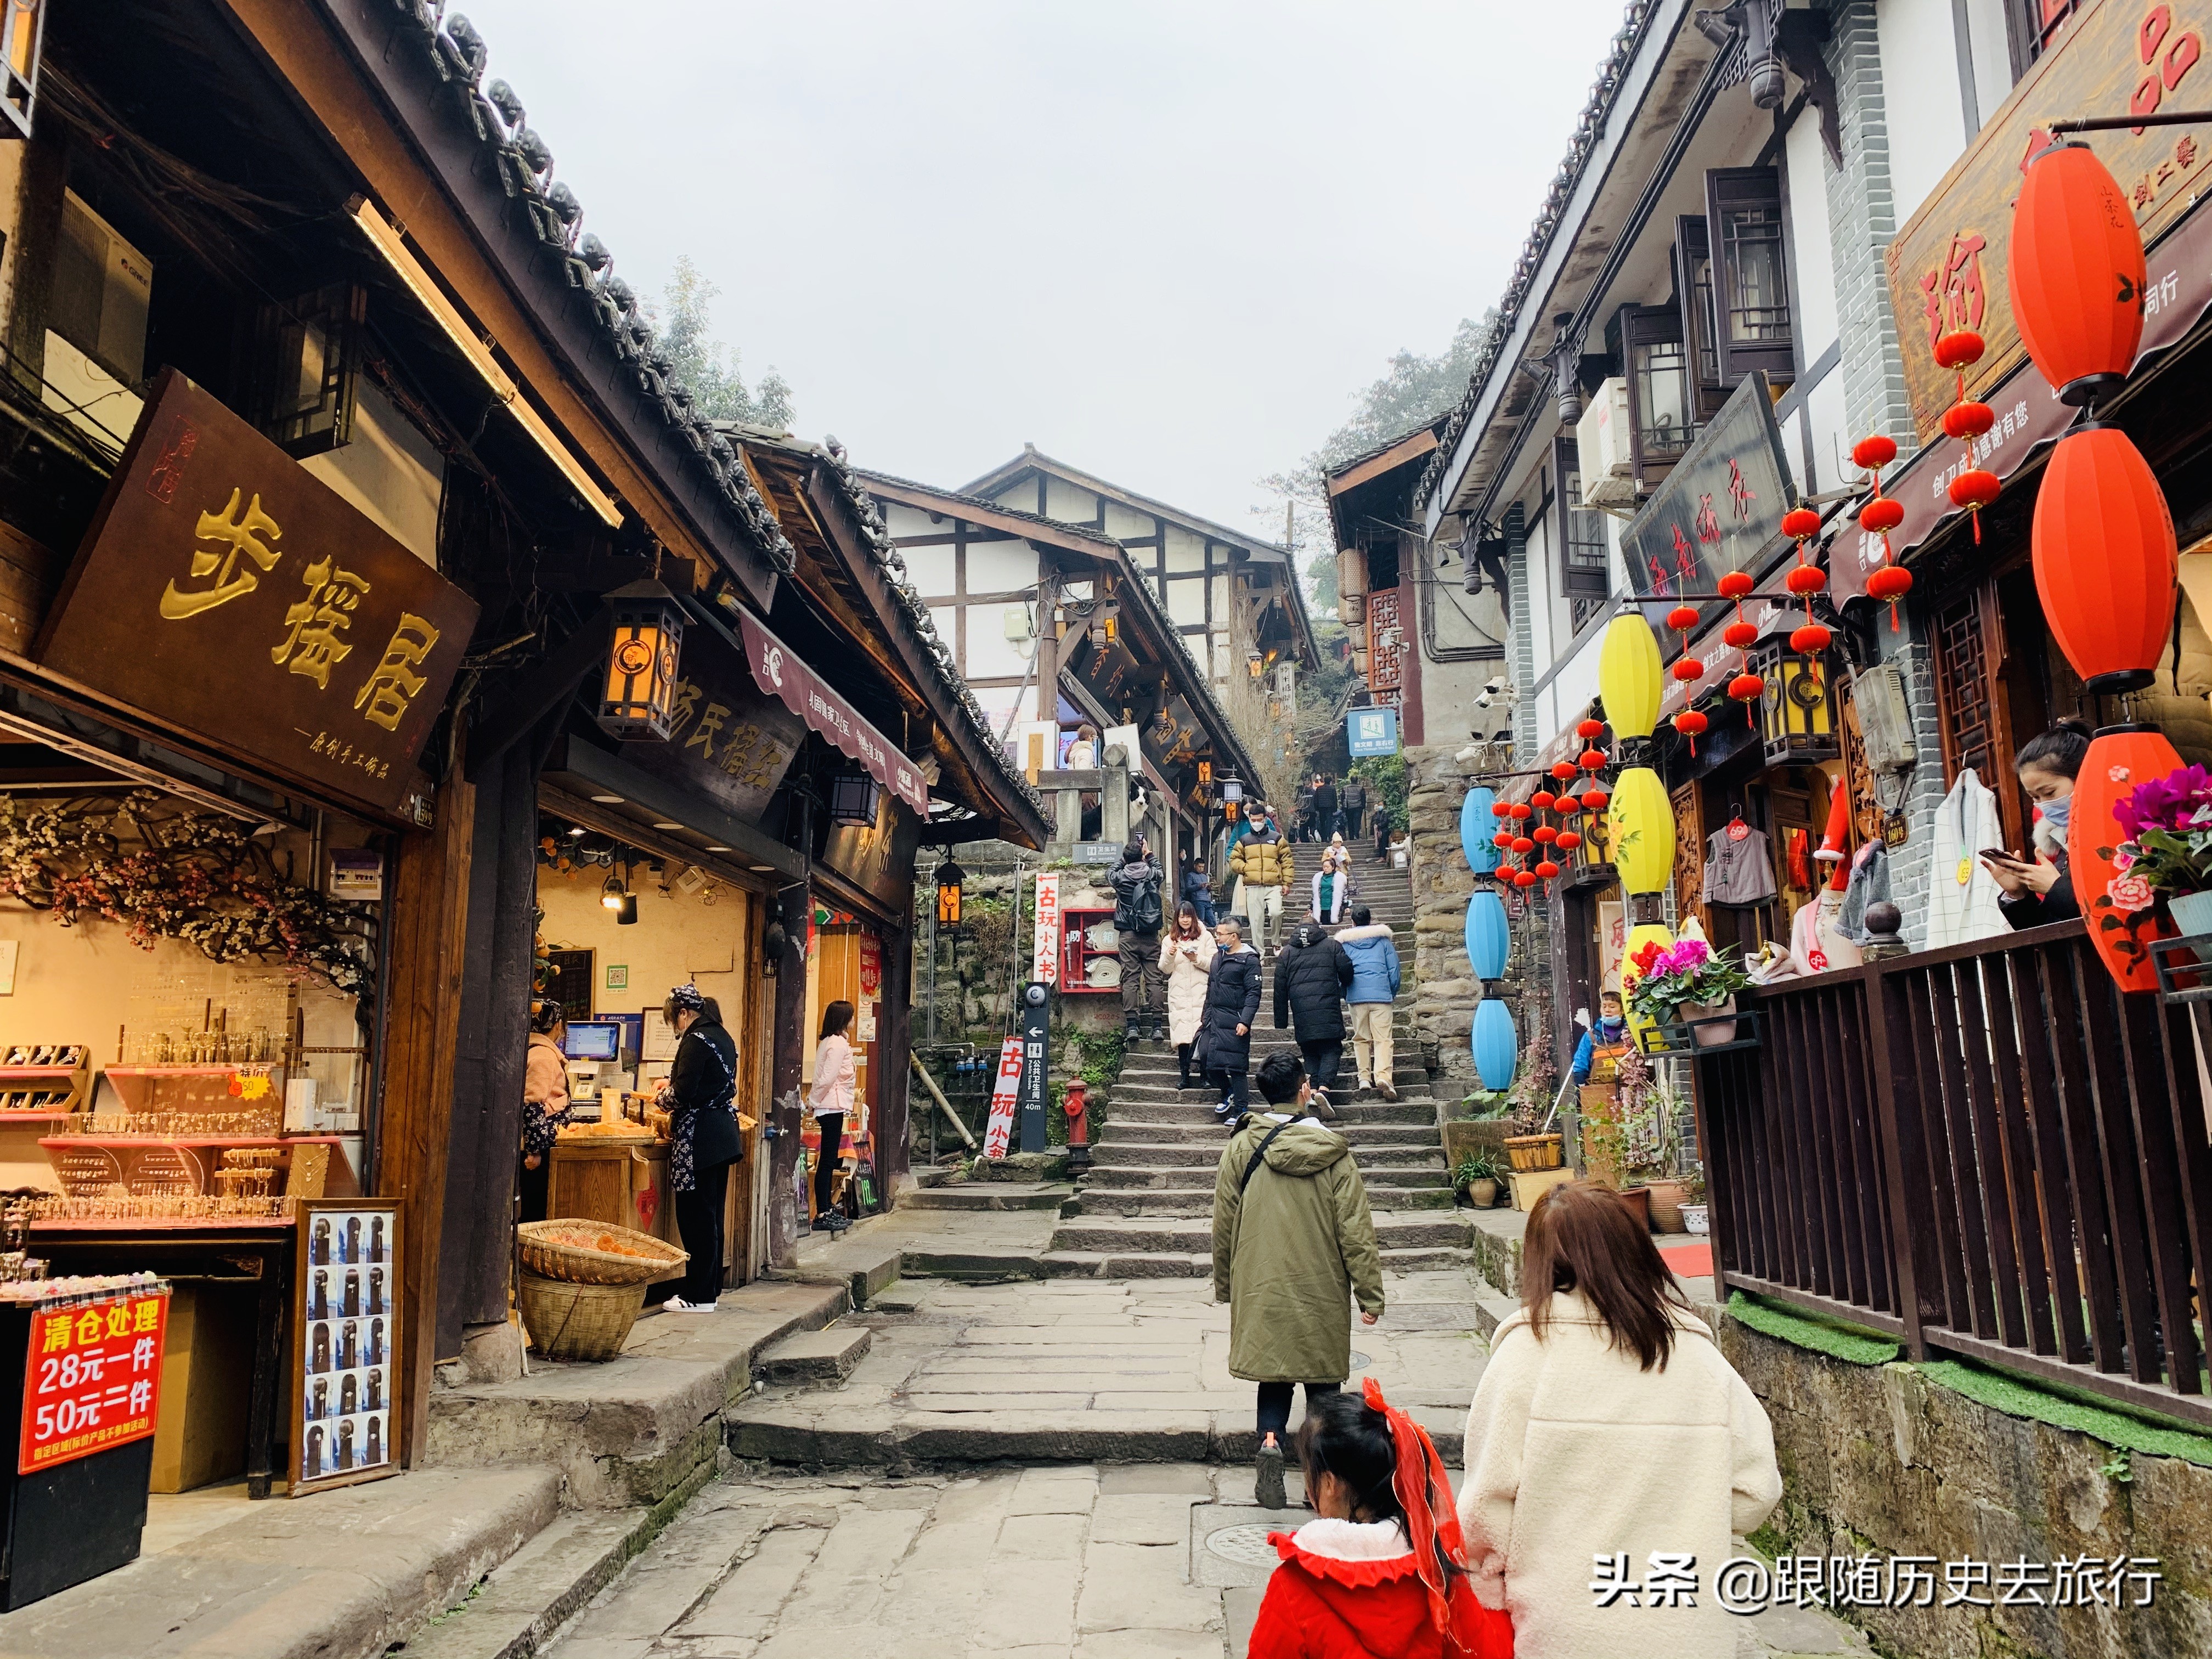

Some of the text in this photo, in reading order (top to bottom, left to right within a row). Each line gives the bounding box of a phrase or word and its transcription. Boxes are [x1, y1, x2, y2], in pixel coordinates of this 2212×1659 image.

[2100, 185, 2125, 229] 山茶花
[129, 267, 148, 287] GREE
[1932, 399, 2029, 499] 创卫成功感谢有您
[159, 487, 440, 731] 步摇居
[1730, 826, 1743, 836] 69
[1888, 826, 1904, 843] 160号
[1037, 886, 1058, 983] 古玩小人书
[1069, 929, 1115, 943] 防火箱
[1032, 1059, 1041, 1099] 公共卫生间
[42, 1300, 159, 1353] 清仓处理
[38, 1336, 155, 1394] 28元一件
[35, 1379, 153, 1440] 50元二件
[33, 1417, 149, 1461] 指定区域(标价产品不参加活动)
